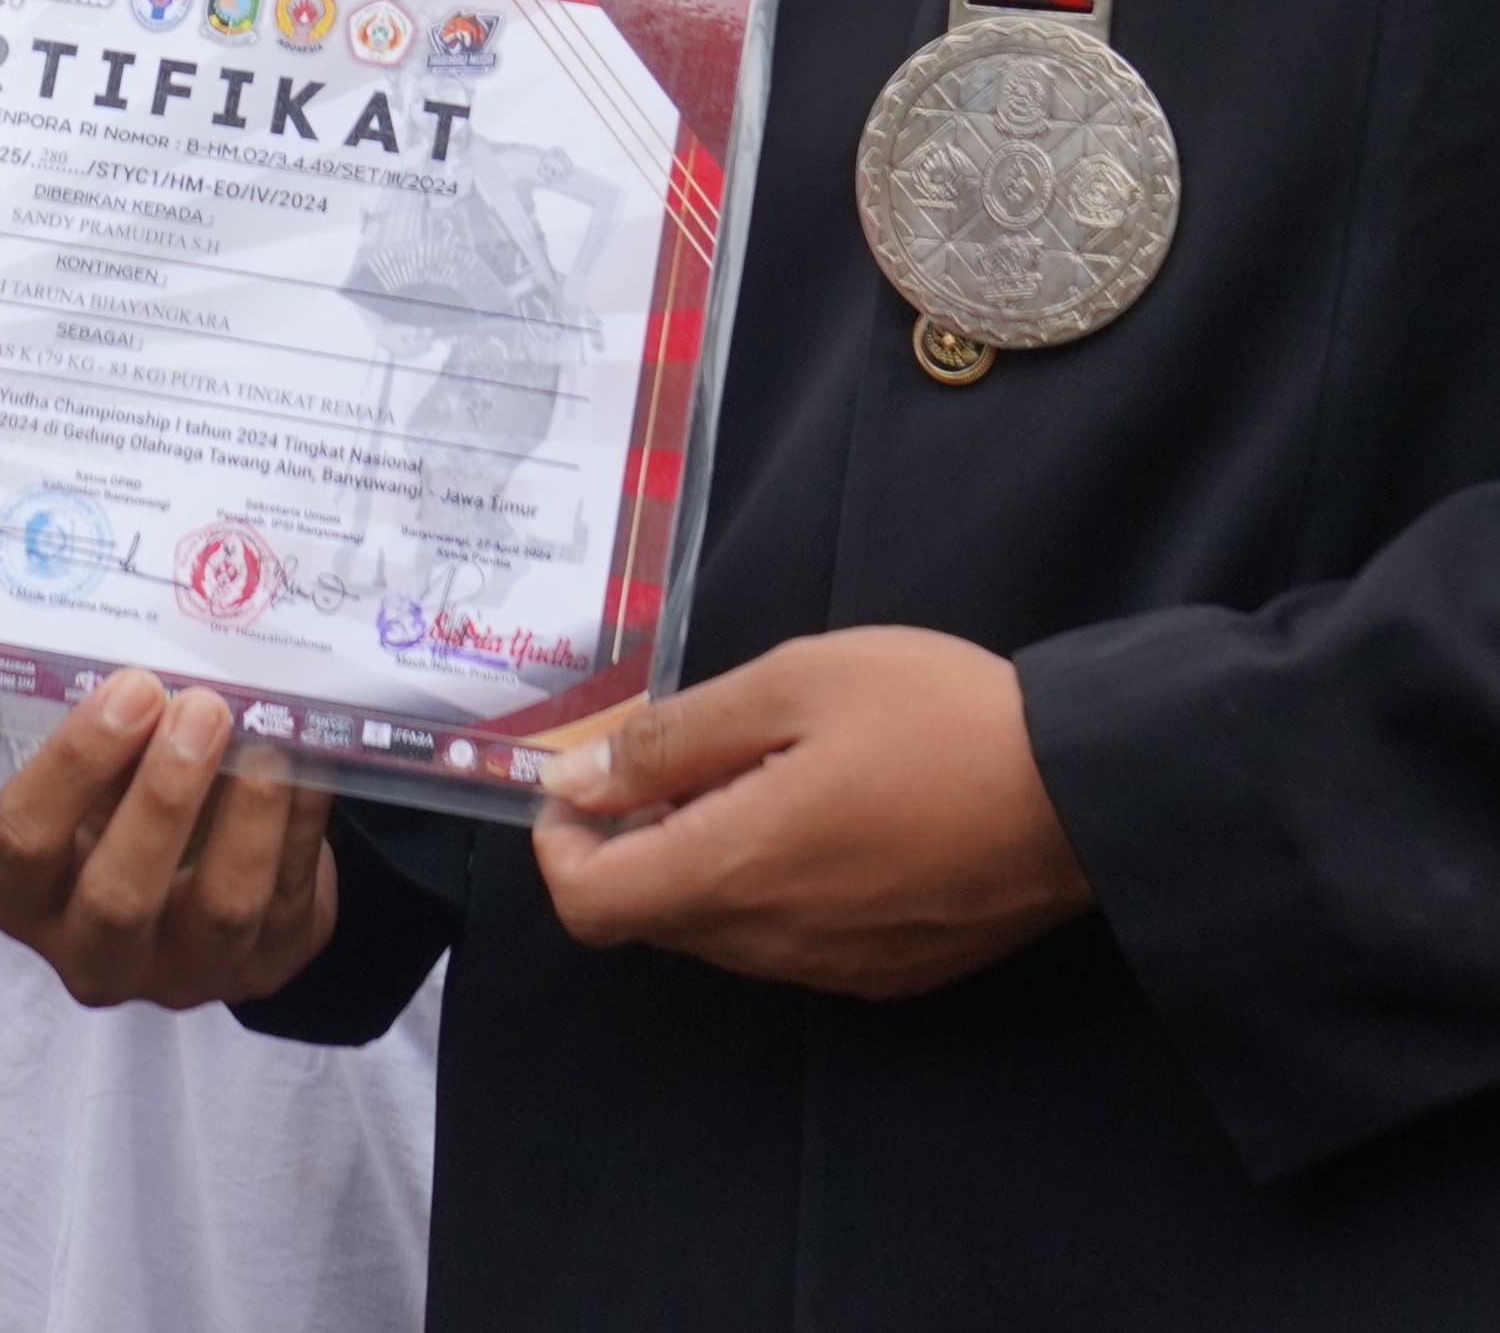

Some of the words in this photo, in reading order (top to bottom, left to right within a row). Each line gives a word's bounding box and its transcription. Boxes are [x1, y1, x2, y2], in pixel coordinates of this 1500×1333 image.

[80, 121, 98, 138] RI
[103, 124, 170, 150] NOMOR
[33, 182, 127, 212] DIBERIKAN
[131, 197, 204, 224] KEPADA
[11, 207, 76, 232] SANDY
[79, 217, 187, 250] PRAMUDITA
[55, 253, 159, 285] KONTINGEN
[12, 280, 86, 308] TARUNA
[90, 292, 234, 332] BHAYANGKARA
[55, 321, 135, 349] SEBAGAI
[19, 346, 34, 362] K
[67, 353, 97, 373] KG
[108, 360, 128, 378] 83
[133, 364, 167, 386] KG)
[170, 371, 232, 397] PUTRA
[236, 382, 319, 411] TINGKAT
[321, 396, 398, 425] REMAJA
[51, 395, 171, 434] Championship
[184, 418, 233, 441] tahun
[235, 426, 279, 448] 2024
[283, 436, 345, 463] Tingkat
[349, 446, 424, 474] Nasional
[42, 418, 60, 436] di
[62, 421, 126, 450] Gedung
[128, 432, 205, 463] Olahraga
[206, 446, 272, 475] Tawang
[275, 459, 318, 483] Alun,
[321, 467, 424, 501] Banyuwangi
[439, 486, 485, 509] Jawa
[487, 494, 540, 519] Timur
